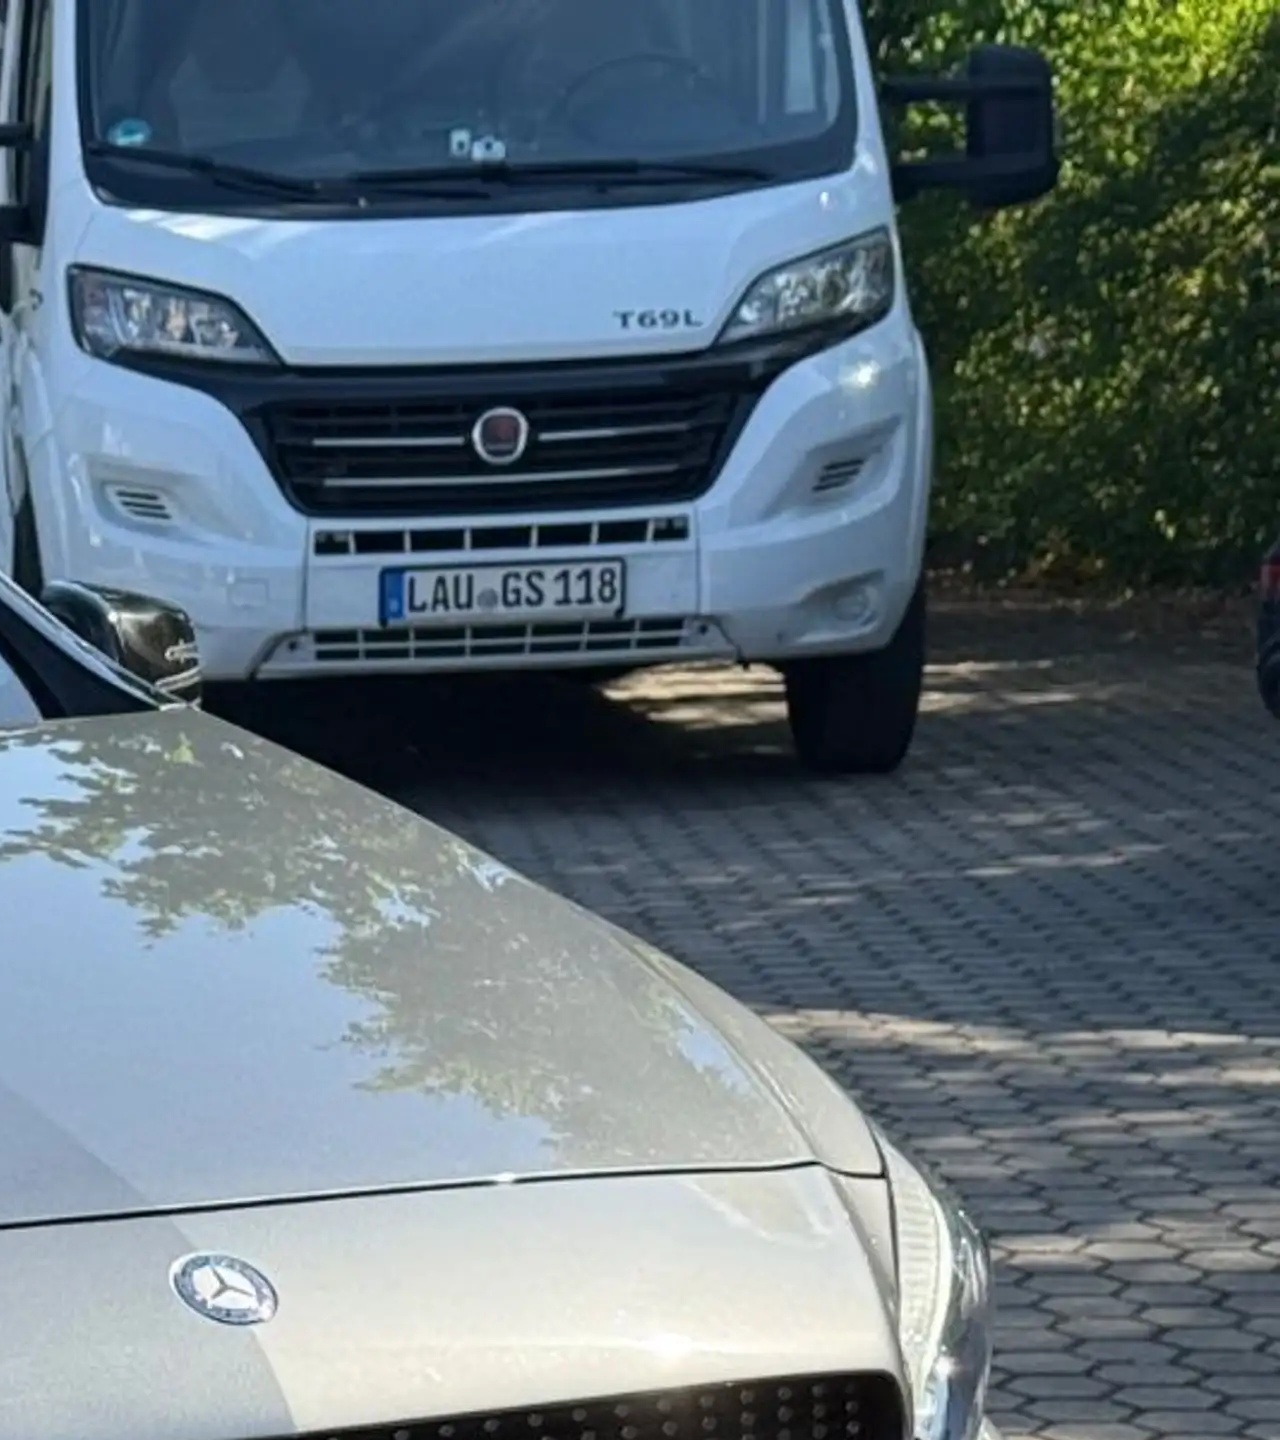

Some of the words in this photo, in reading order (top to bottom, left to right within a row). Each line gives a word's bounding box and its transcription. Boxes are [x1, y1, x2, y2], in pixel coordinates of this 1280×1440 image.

[612, 308, 704, 329] T69L
[408, 573, 474, 613] LAU
[501, 571, 546, 608] GS
[553, 567, 618, 607] 118
